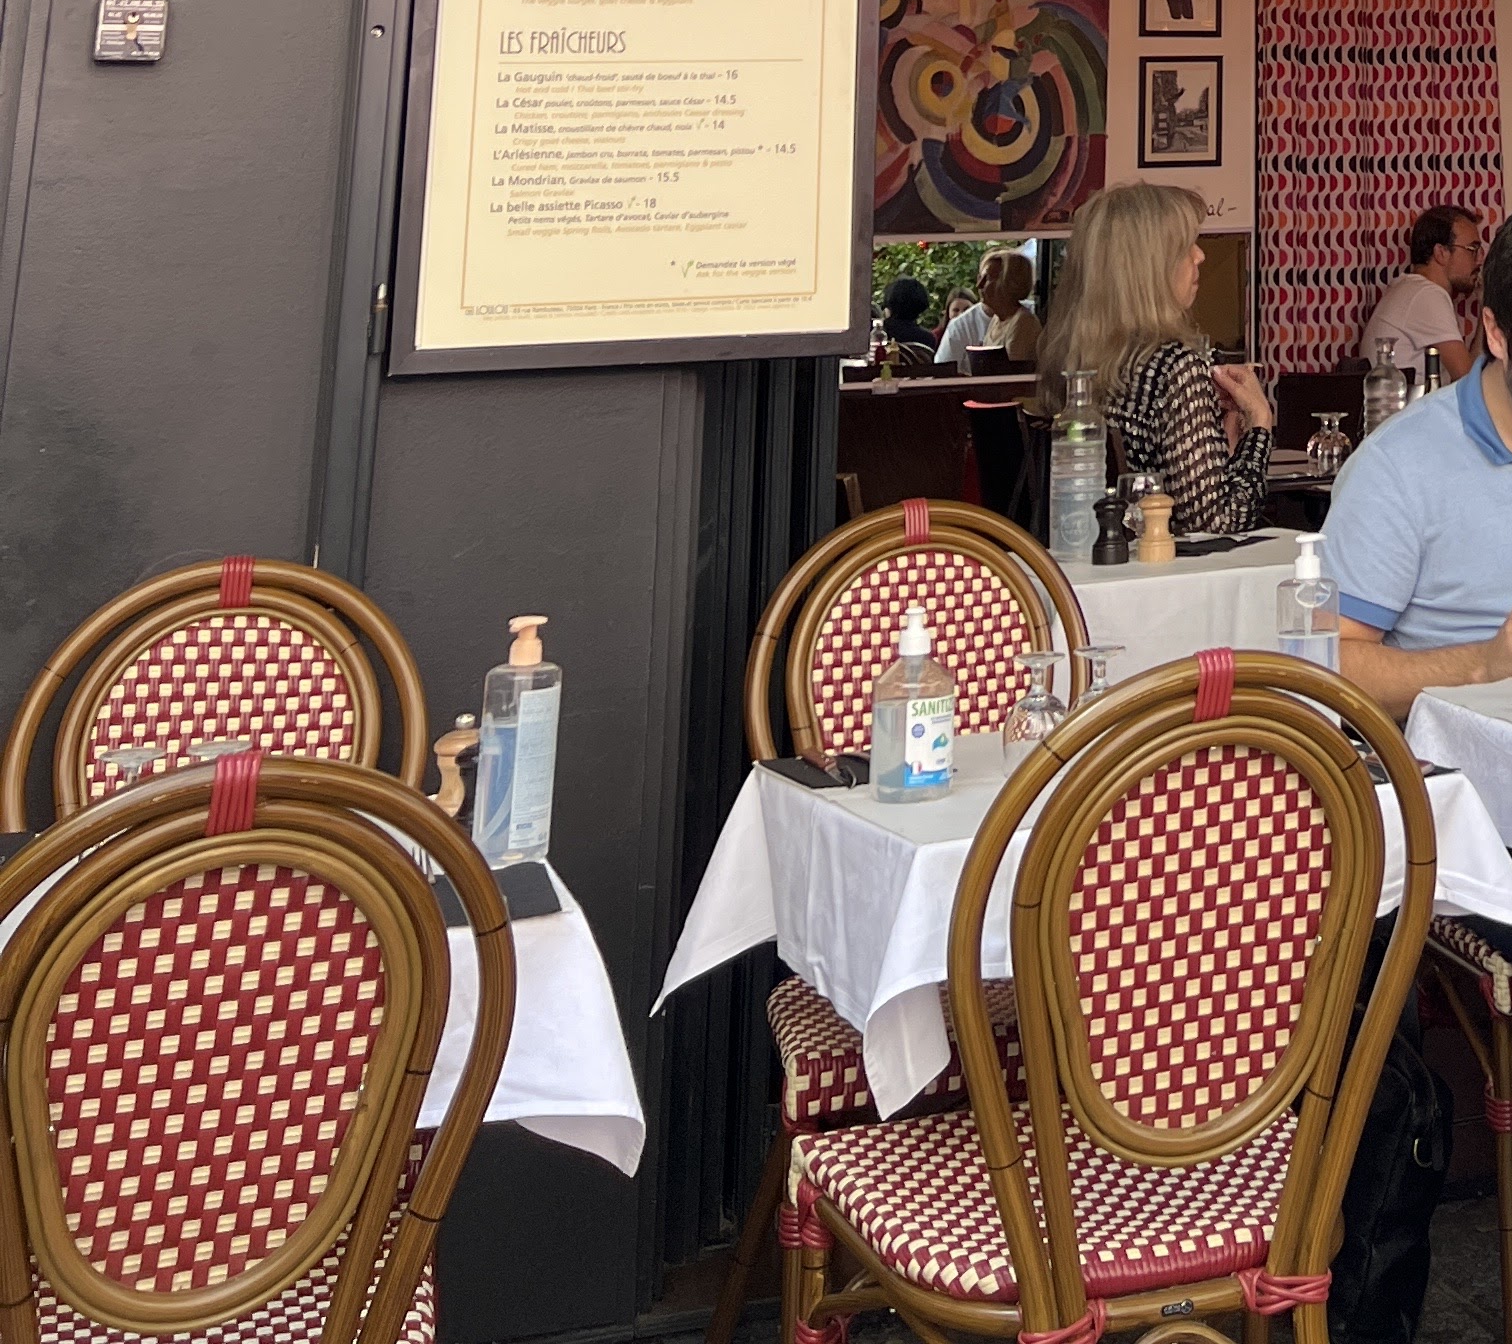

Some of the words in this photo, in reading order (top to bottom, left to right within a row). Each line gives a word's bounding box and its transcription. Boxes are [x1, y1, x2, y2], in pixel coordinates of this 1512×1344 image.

[499, 30, 523, 54] LES
[530, 27, 625, 53] FRAÎCHEURS
[497, 71, 510, 82] La
[513, 71, 562, 84] Gauguin
[725, 69, 738, 80] 16
[495, 97, 509, 108] La
[512, 97, 543, 108] César
[714, 94, 736, 104] 14.5
[494, 123, 507, 134] La
[712, 119, 724, 129] 14
[775, 143, 795, 153] 14.5
[491, 175, 504, 186] La
[657, 171, 679, 182] 15.5
[489, 202, 503, 212] La
[506, 200, 534, 212] belle
[537, 200, 580, 211] assiette
[583, 199, 623, 209] Picasso
[643, 197, 656, 208] 18
